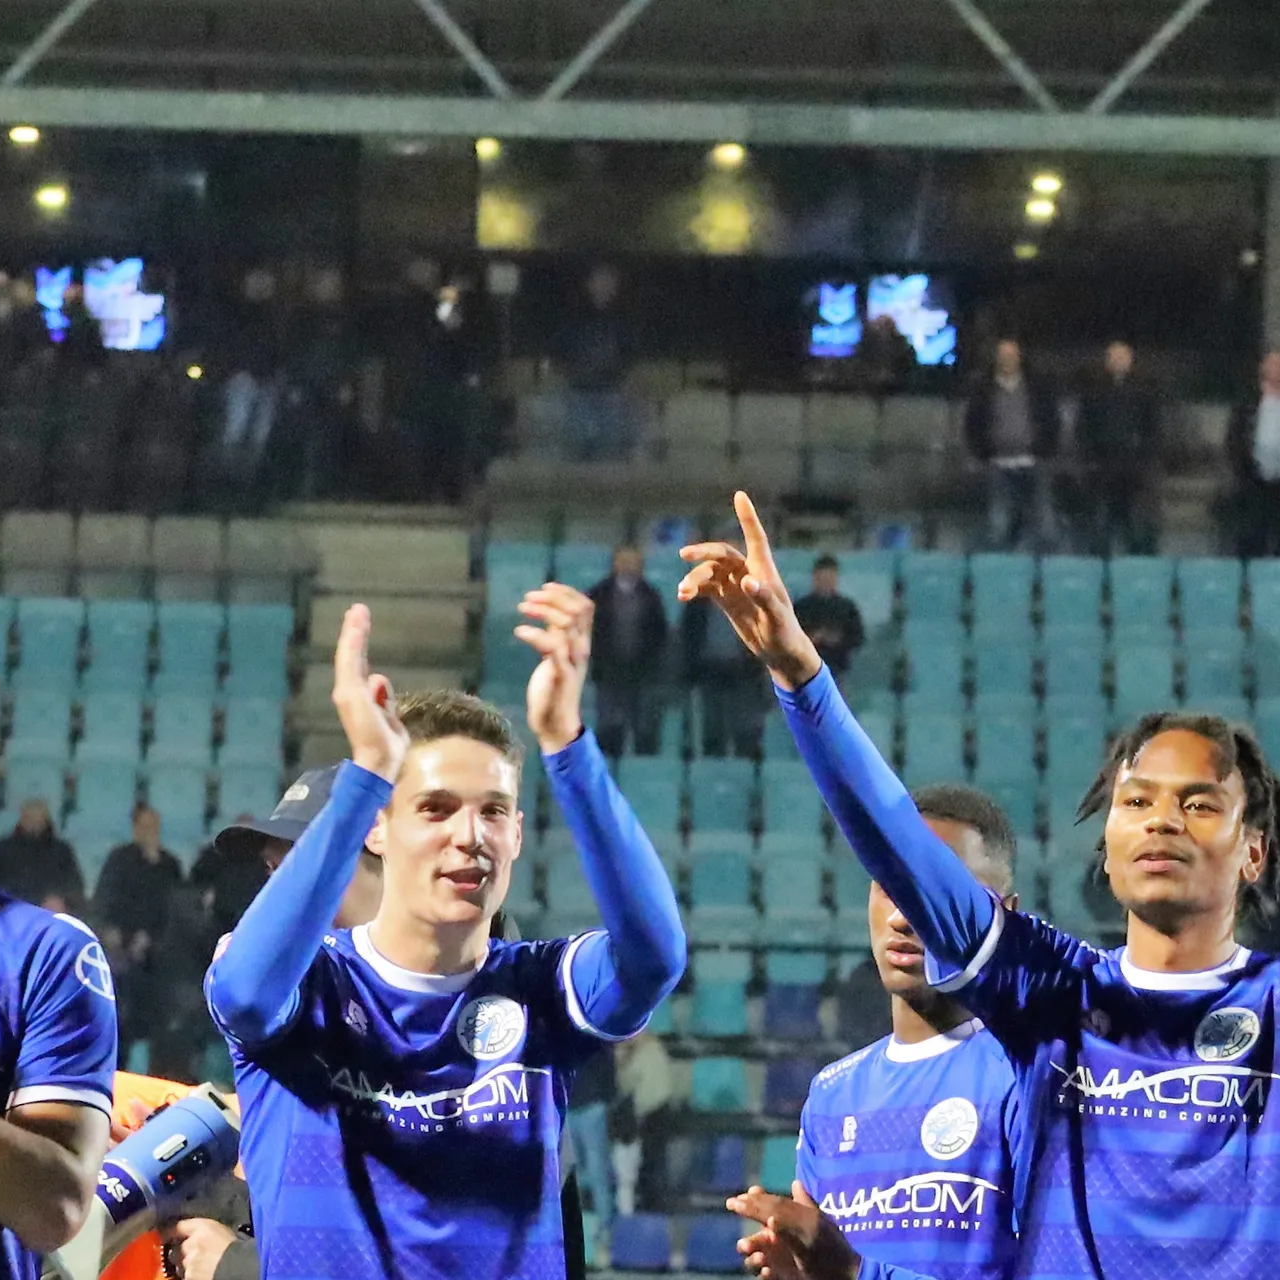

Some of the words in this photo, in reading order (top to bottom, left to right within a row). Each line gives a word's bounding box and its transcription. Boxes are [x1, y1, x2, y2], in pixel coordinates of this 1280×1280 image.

[330, 1068, 529, 1120] AMACOM
[1062, 1066, 1265, 1108] AMACOM
[900, 1217, 982, 1232] COMPANY
